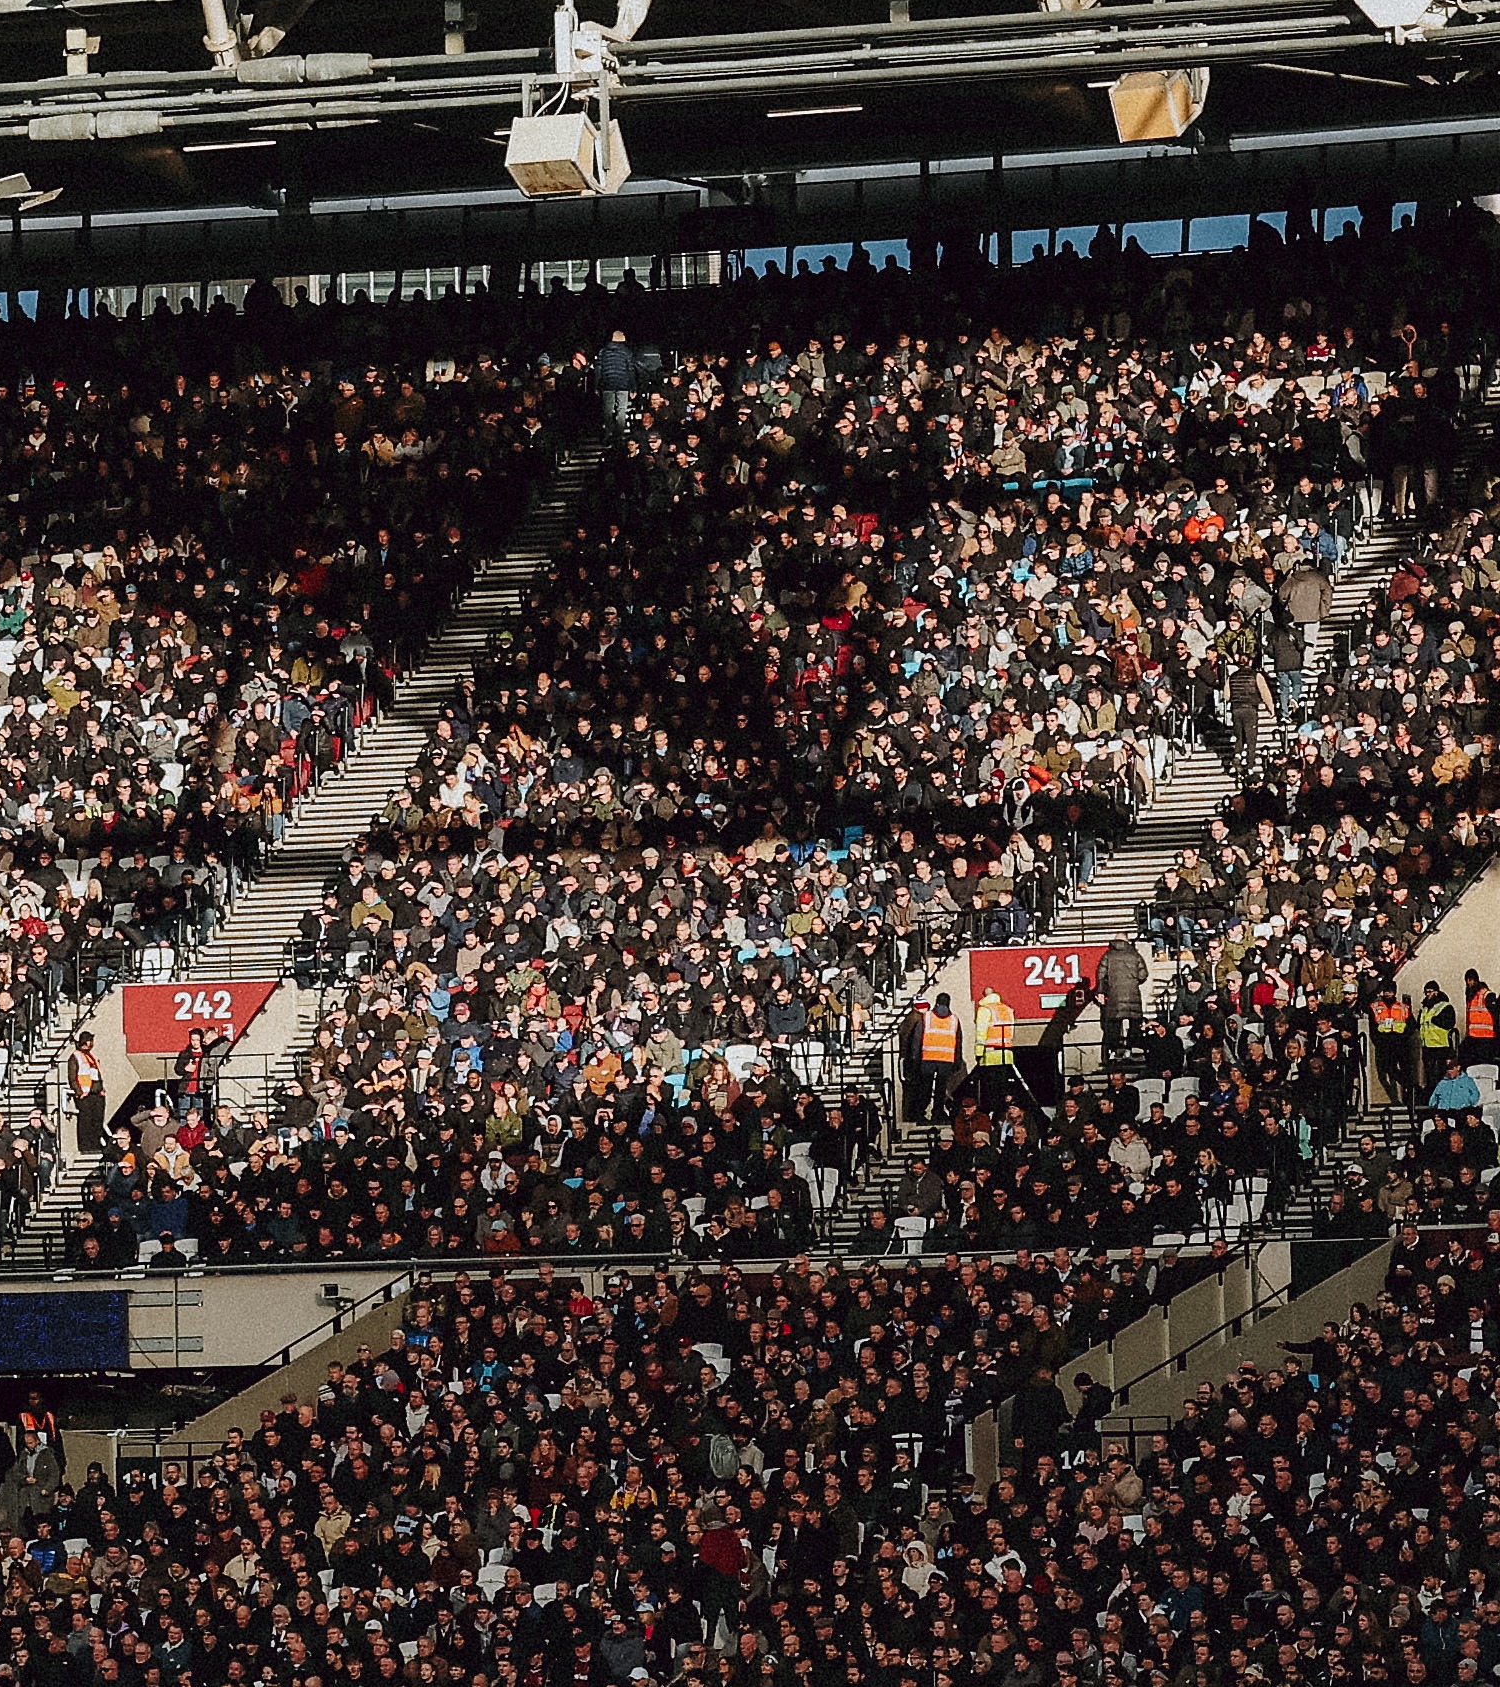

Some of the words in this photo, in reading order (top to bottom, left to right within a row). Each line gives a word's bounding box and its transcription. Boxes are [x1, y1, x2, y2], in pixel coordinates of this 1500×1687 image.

[1024, 954, 1083, 986] 241
[174, 990, 232, 1020] 242
[123, 1472, 157, 1490] 11
